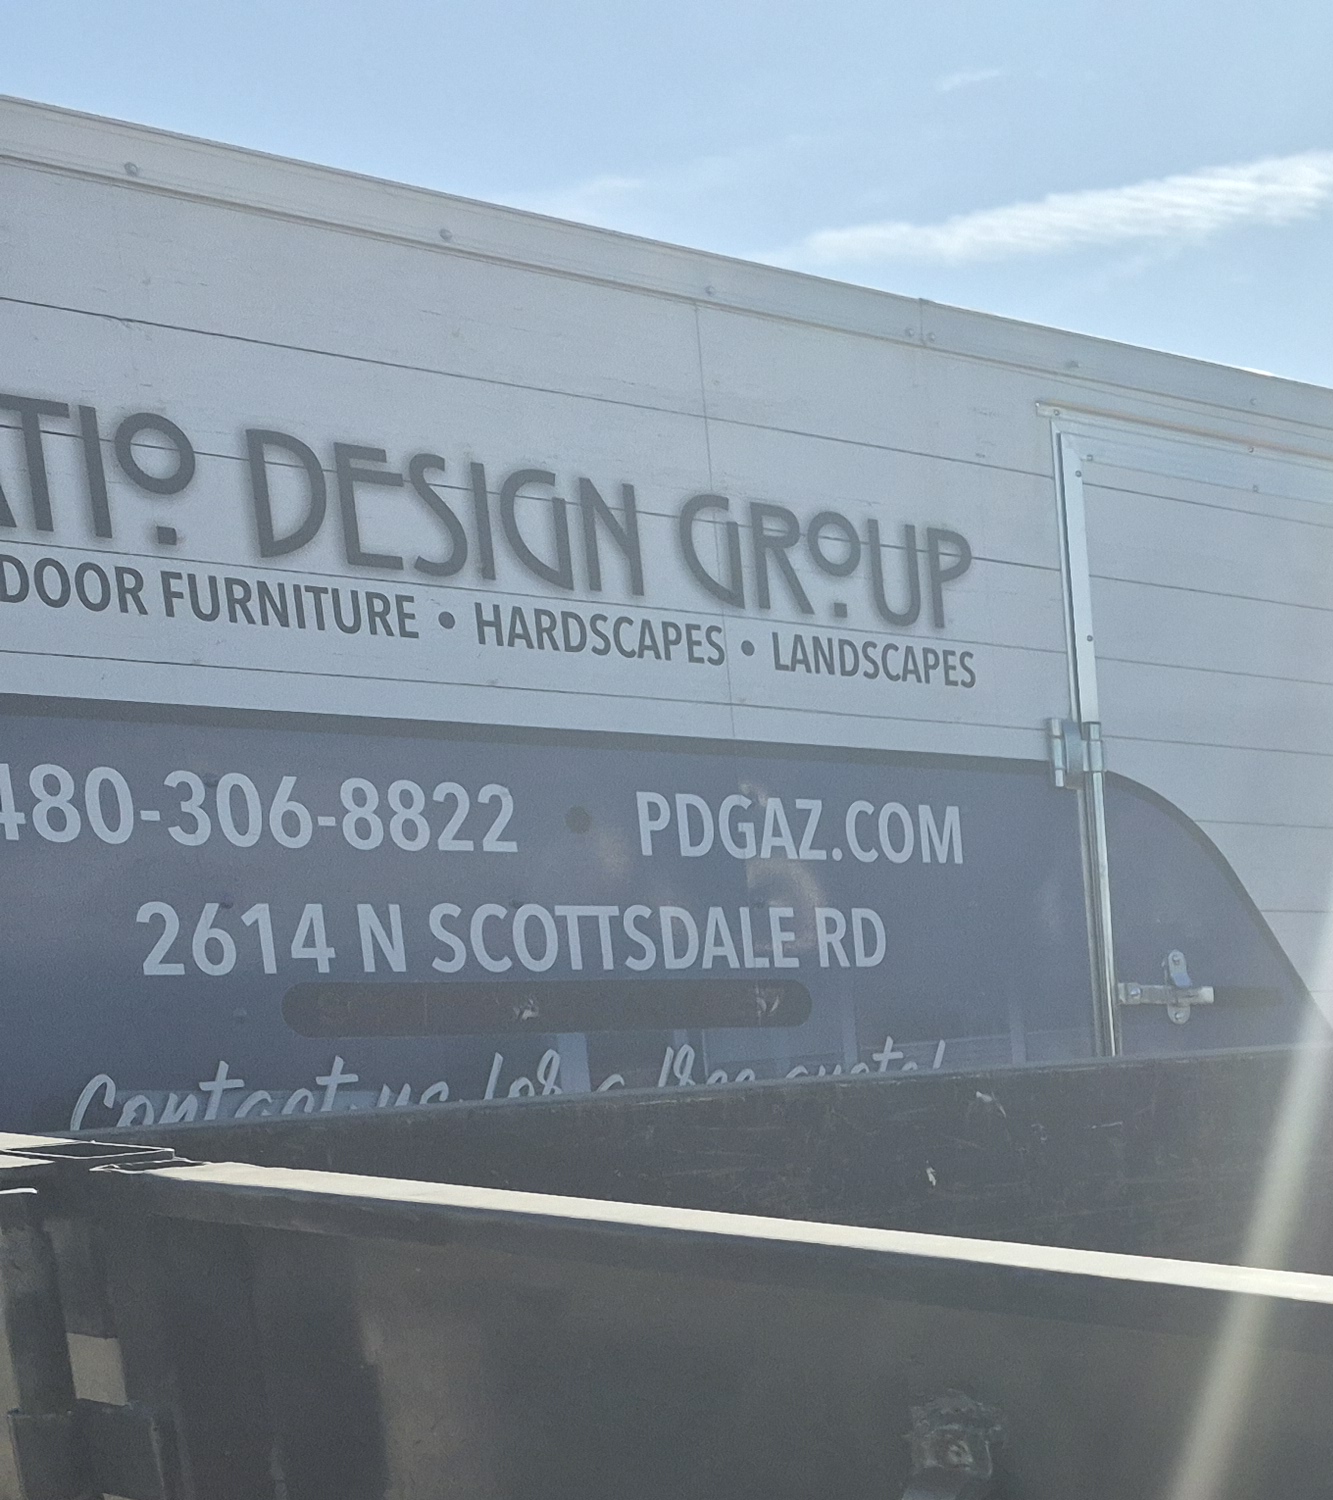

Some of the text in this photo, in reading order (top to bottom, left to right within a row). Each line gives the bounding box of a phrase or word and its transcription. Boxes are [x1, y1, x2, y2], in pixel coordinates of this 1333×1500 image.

[0, 393, 974, 630] TIO DESIGN GROUP
[0, 554, 977, 690] DOOR FURNITURE HARDSCAPES LANDSCAPES
[0, 762, 964, 865] 480-306-8822 PDGAZ.COM
[136, 900, 888, 977] 2614 N SCOTTSDALE RD
